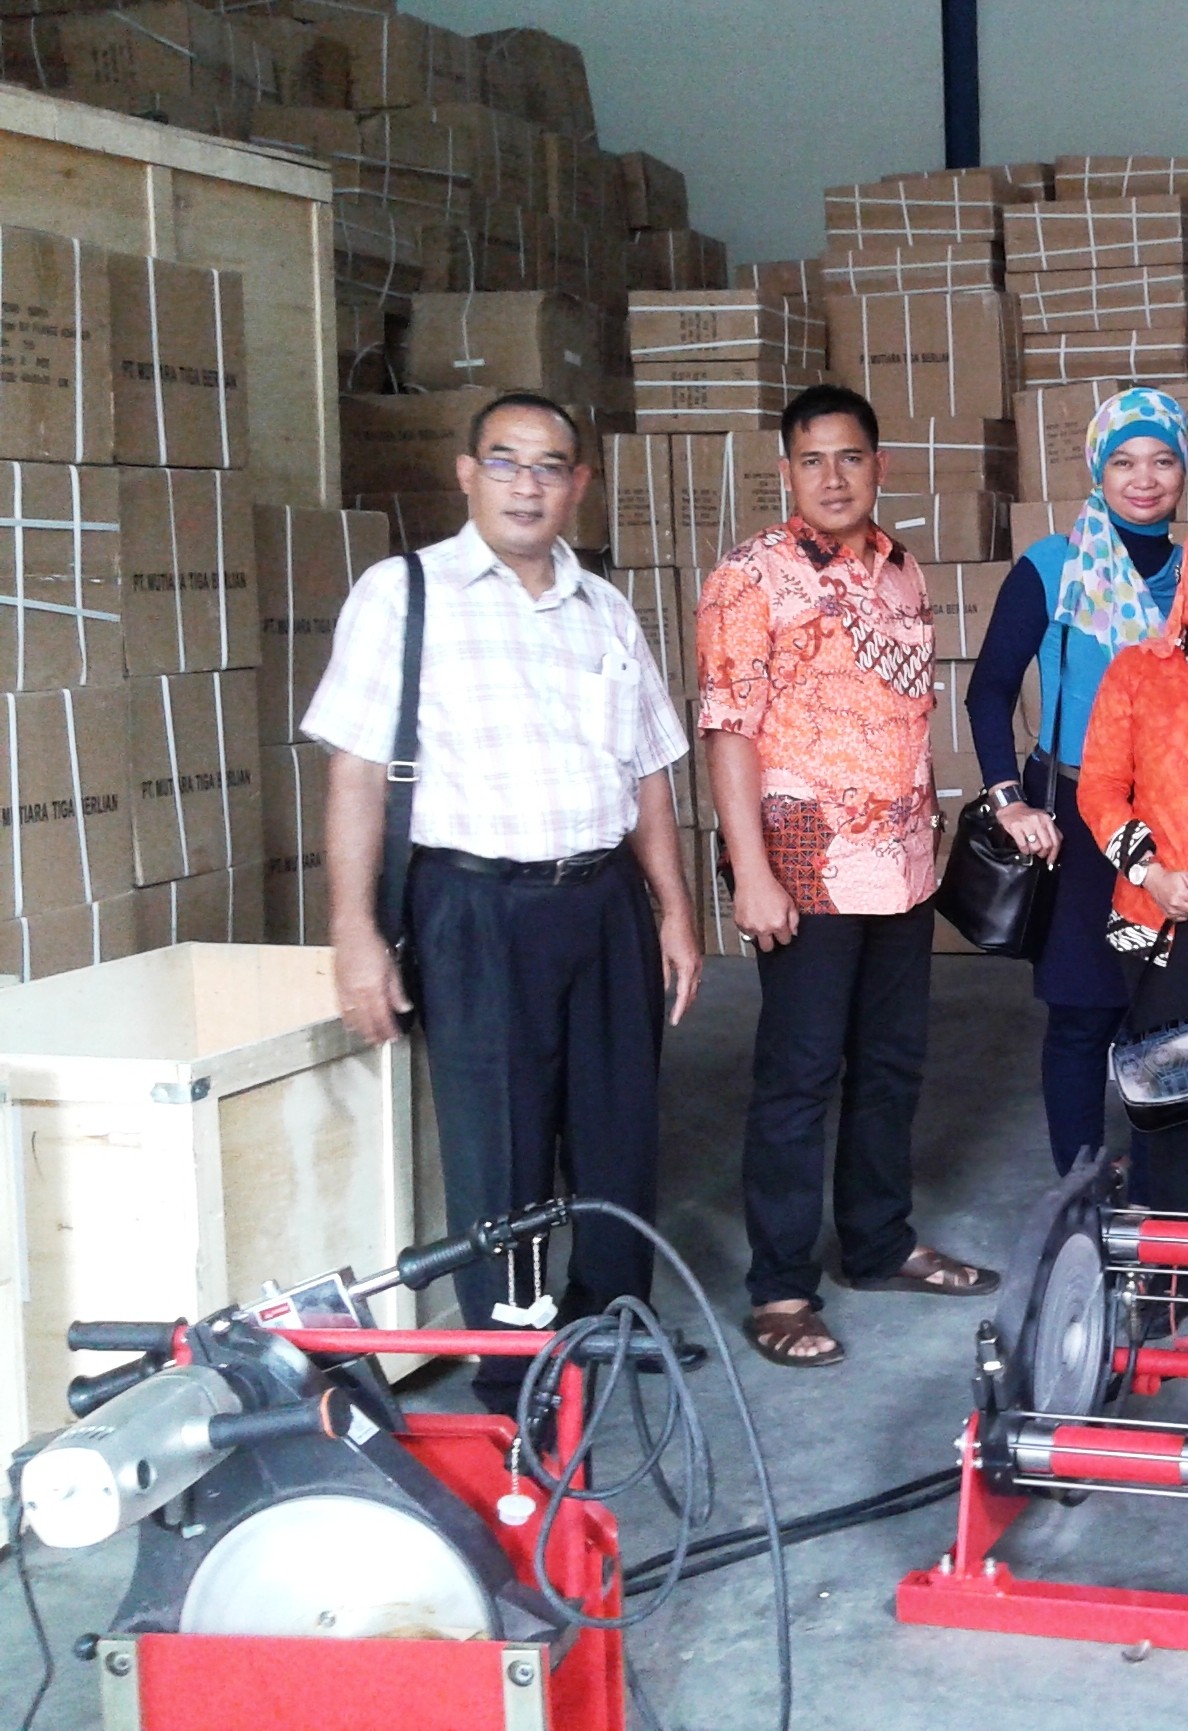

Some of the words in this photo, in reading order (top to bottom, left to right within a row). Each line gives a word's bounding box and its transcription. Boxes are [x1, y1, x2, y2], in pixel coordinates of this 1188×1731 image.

[946, 604, 978, 615] BERIAN
[217, 767, 251, 790] BRLIAN
[2, 801, 49, 826] MTIARA
